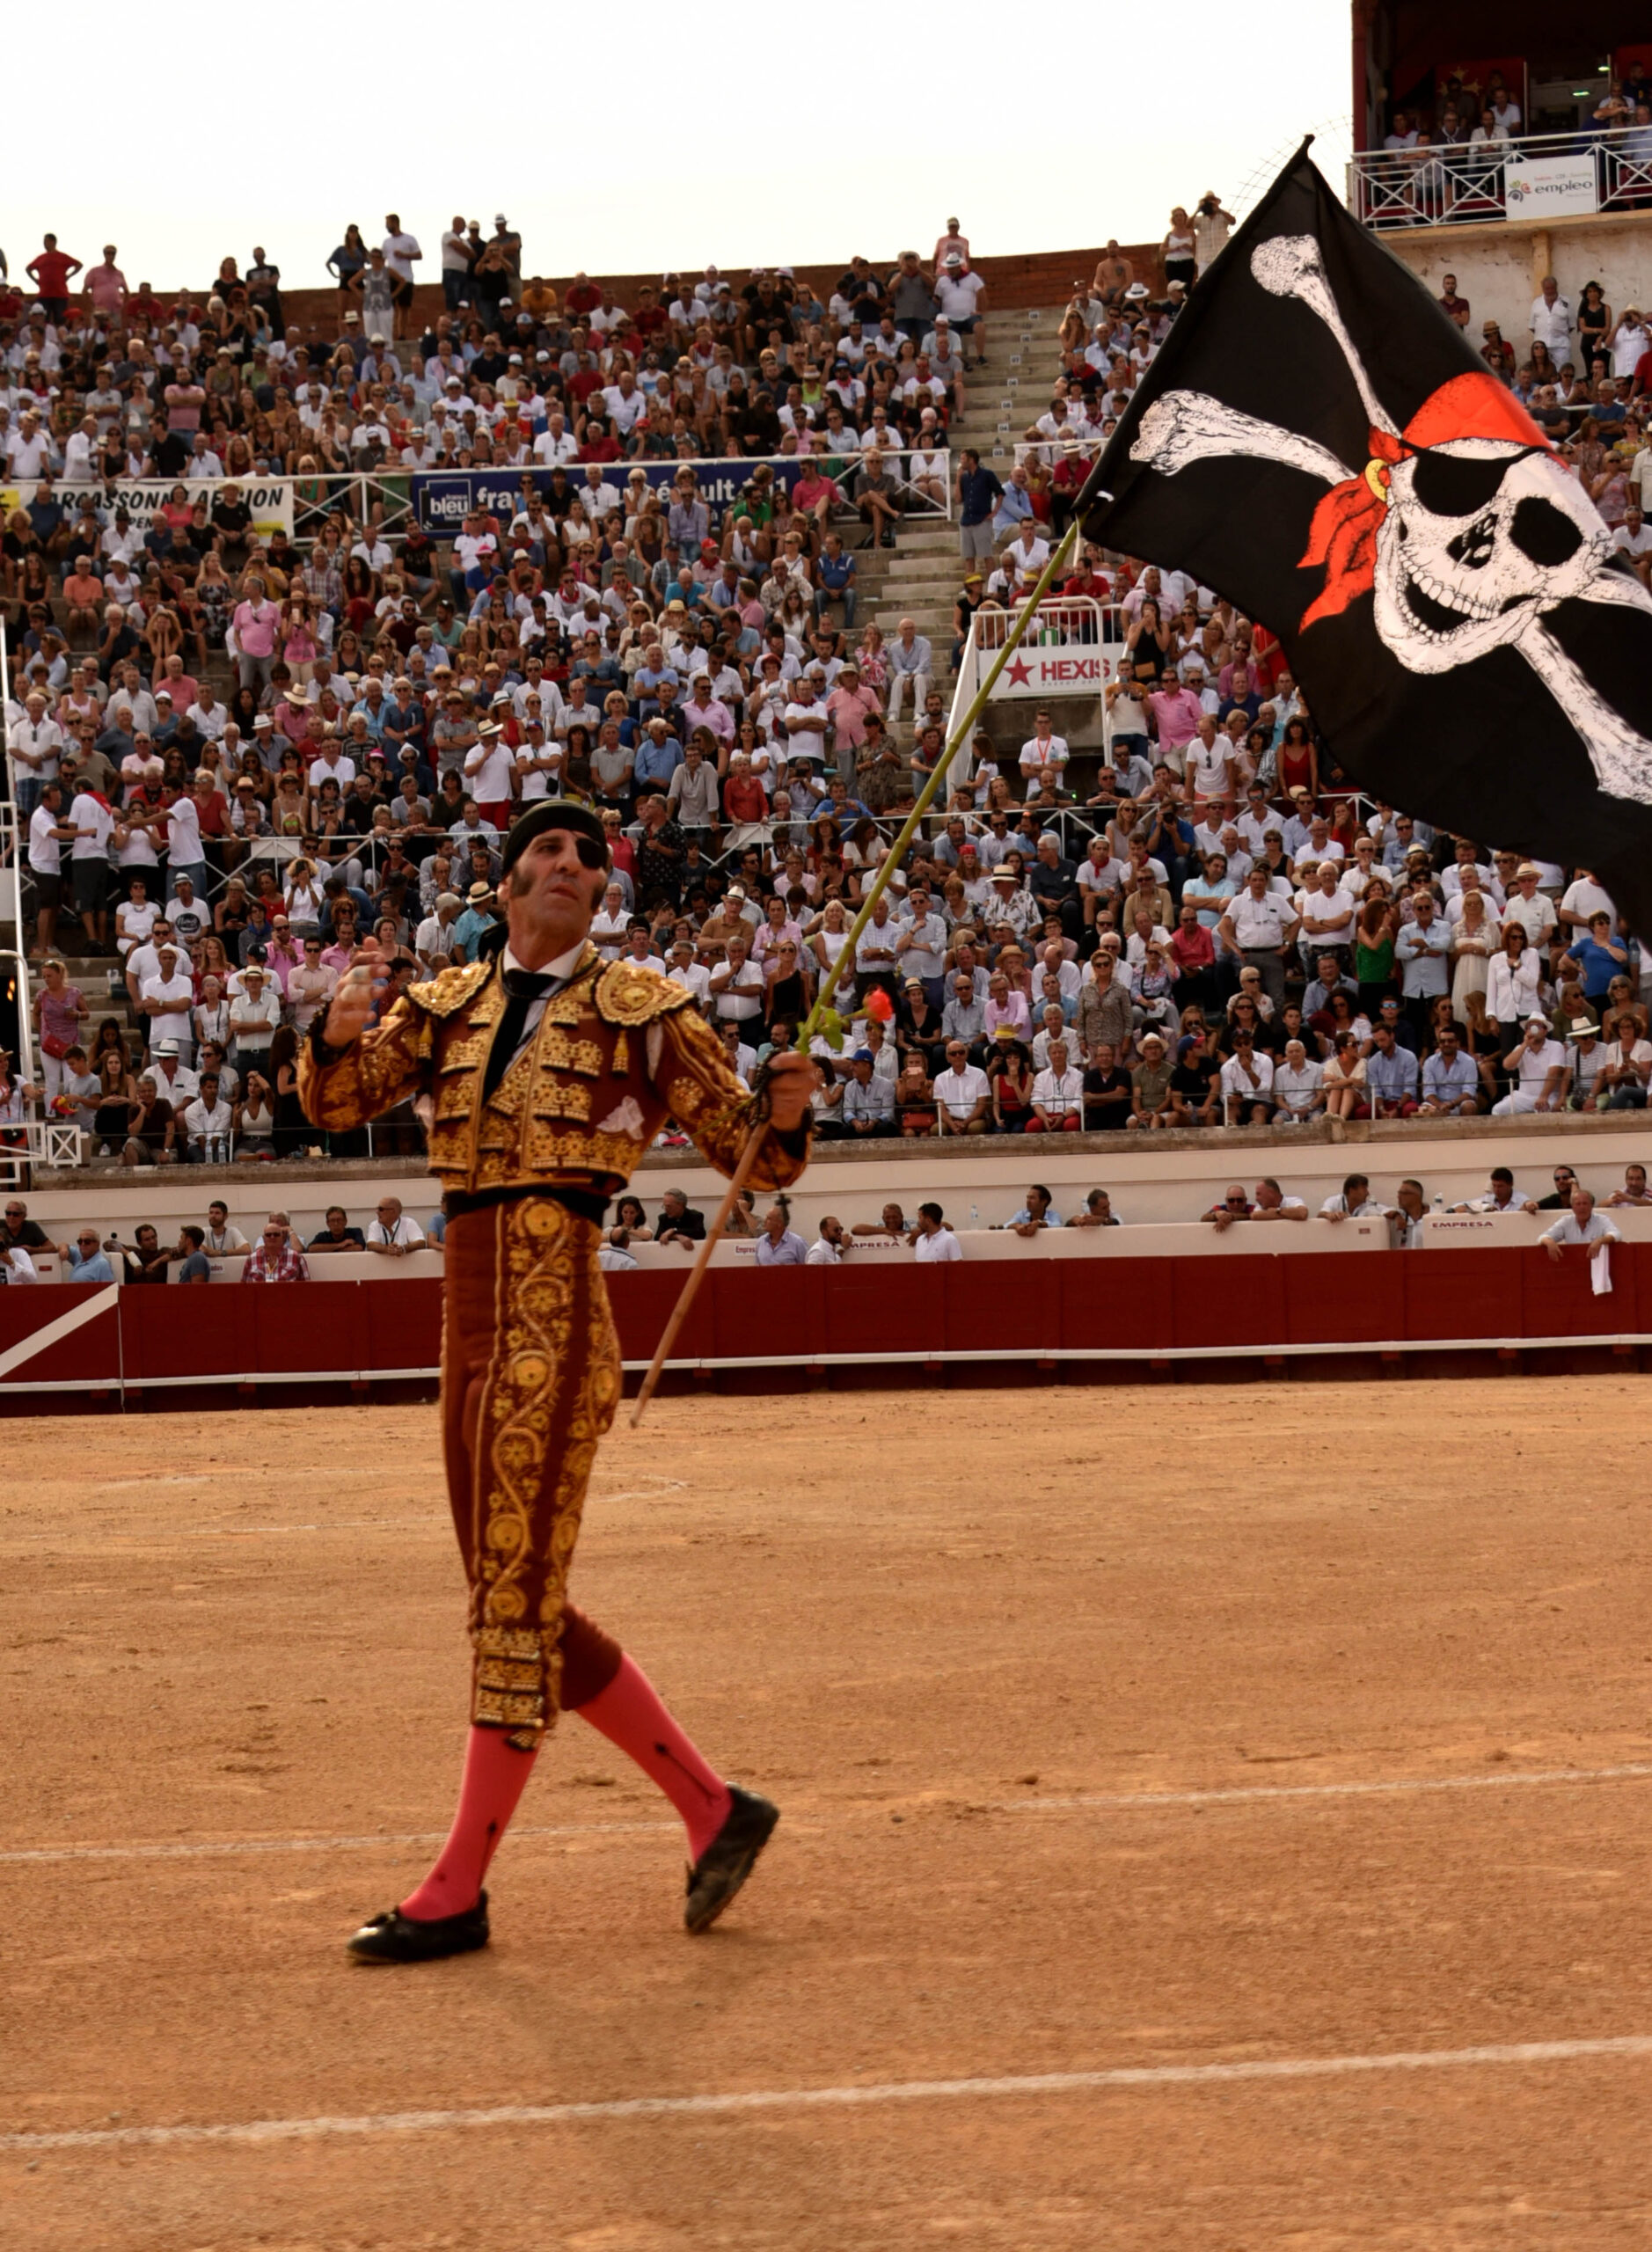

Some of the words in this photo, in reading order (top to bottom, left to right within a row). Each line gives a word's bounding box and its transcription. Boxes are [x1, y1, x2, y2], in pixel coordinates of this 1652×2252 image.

[1534, 179, 1593, 194] empleo
[430, 496, 468, 515] bleu
[1041, 657, 1111, 681] HEXIS
[1432, 1220, 1494, 1229] EMPRESA
[735, 1245, 757, 1254] Empres
